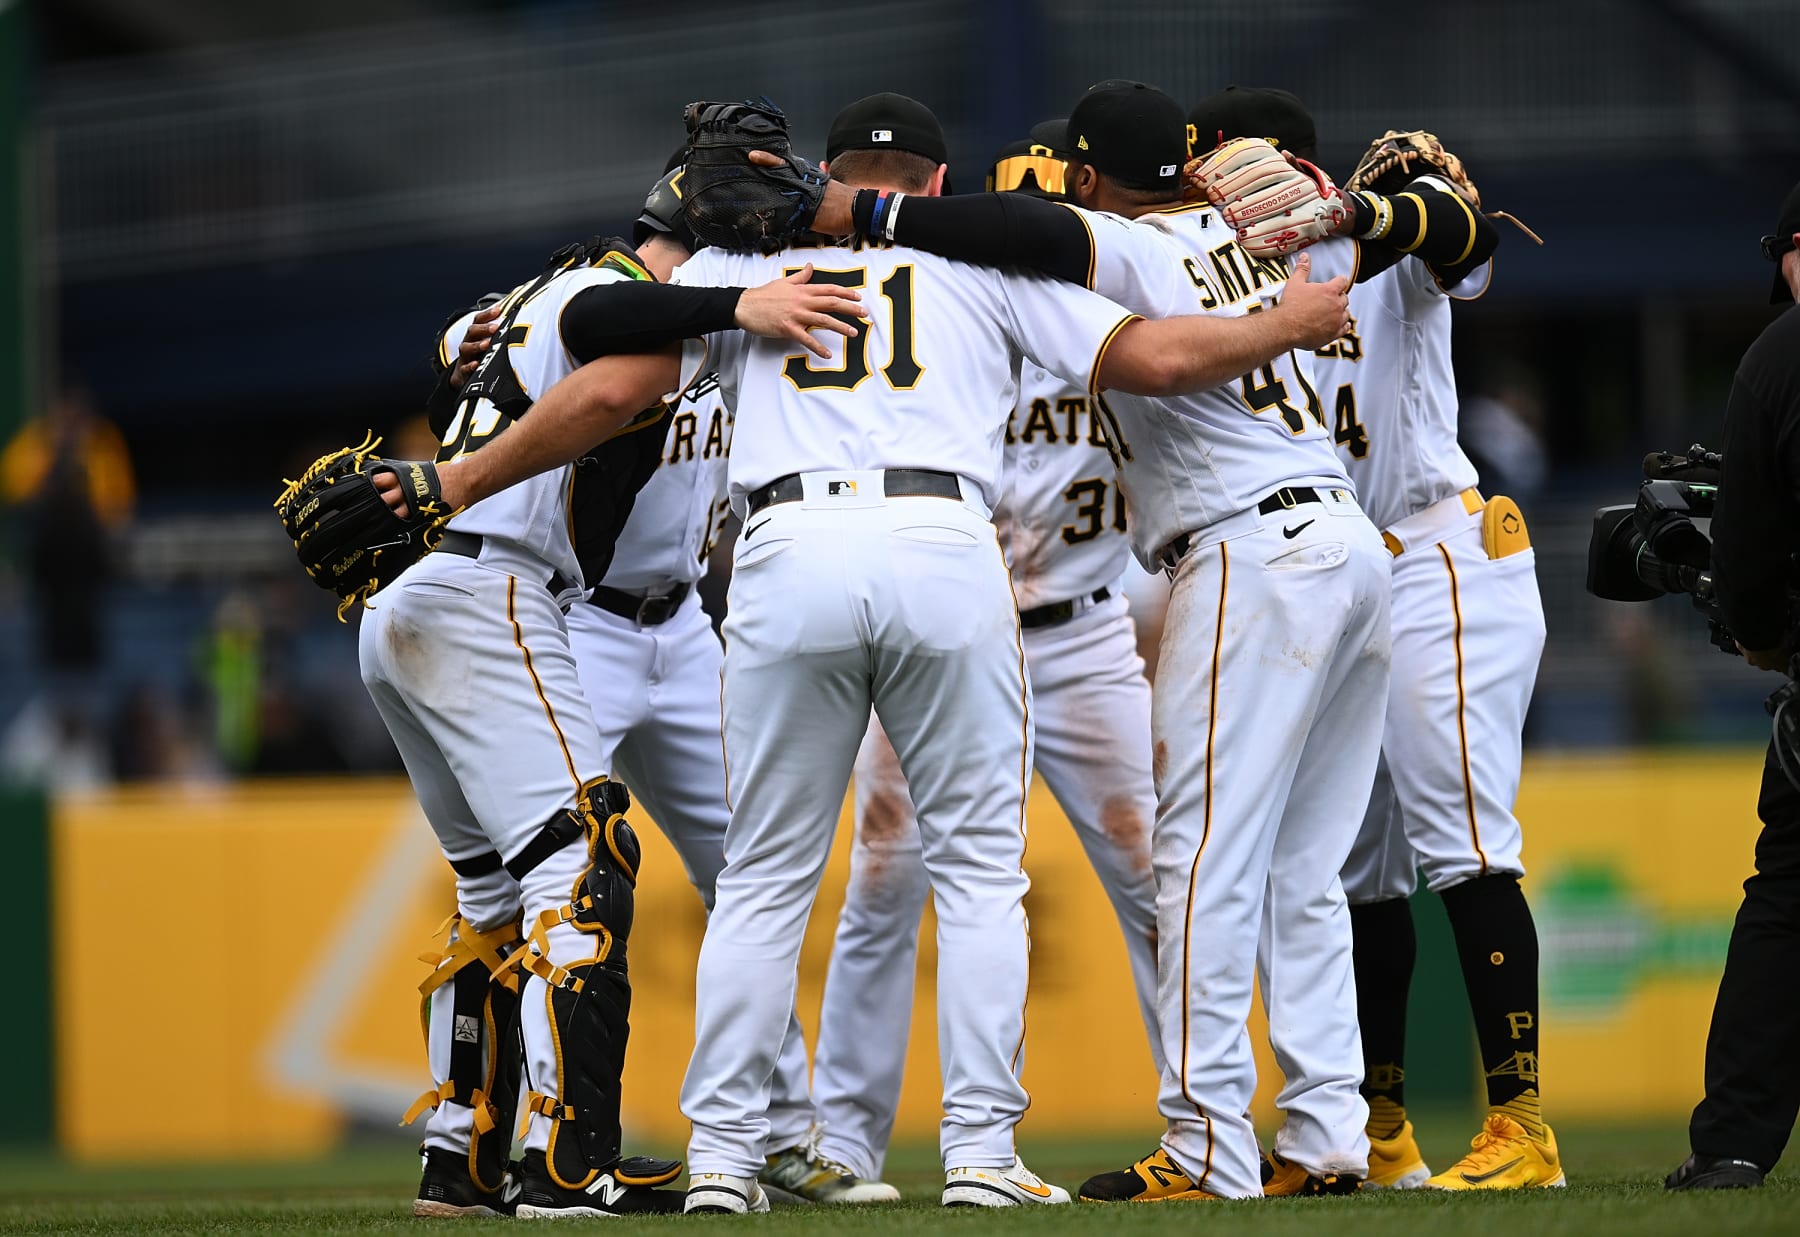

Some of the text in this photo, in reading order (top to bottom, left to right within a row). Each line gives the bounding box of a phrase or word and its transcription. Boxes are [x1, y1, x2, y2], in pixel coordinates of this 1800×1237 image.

[1241, 187, 1301, 217] BENDECIDO POR DIOS
[781, 263, 927, 392] 51
[1505, 1010, 1534, 1039] P
